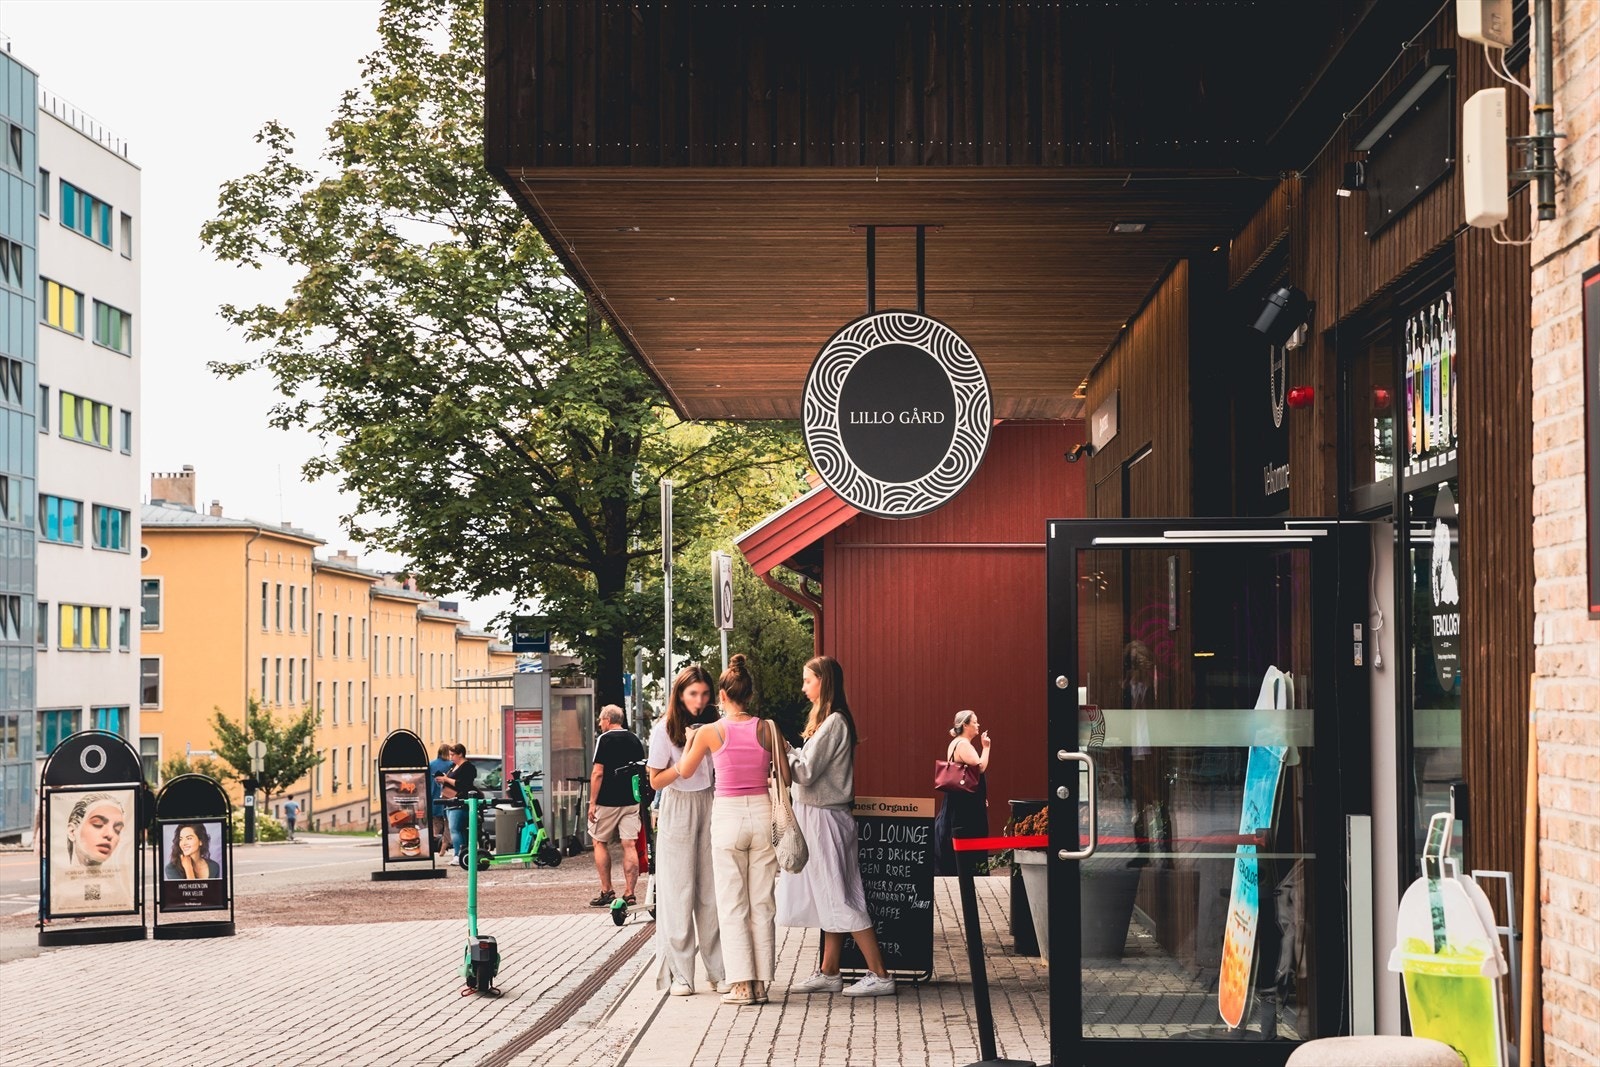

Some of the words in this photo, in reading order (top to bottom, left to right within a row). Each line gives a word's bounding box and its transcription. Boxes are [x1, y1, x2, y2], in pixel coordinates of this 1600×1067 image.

[850, 411, 894, 424] LILLO
[899, 408, 945, 424] GÅRD
[854, 802, 876, 811] nest
[879, 802, 918, 813] Organic
[856, 821, 871, 841] LO
[879, 822, 929, 845] LOUNGE
[859, 848, 874, 859] AT
[859, 862, 880, 874] GEN
